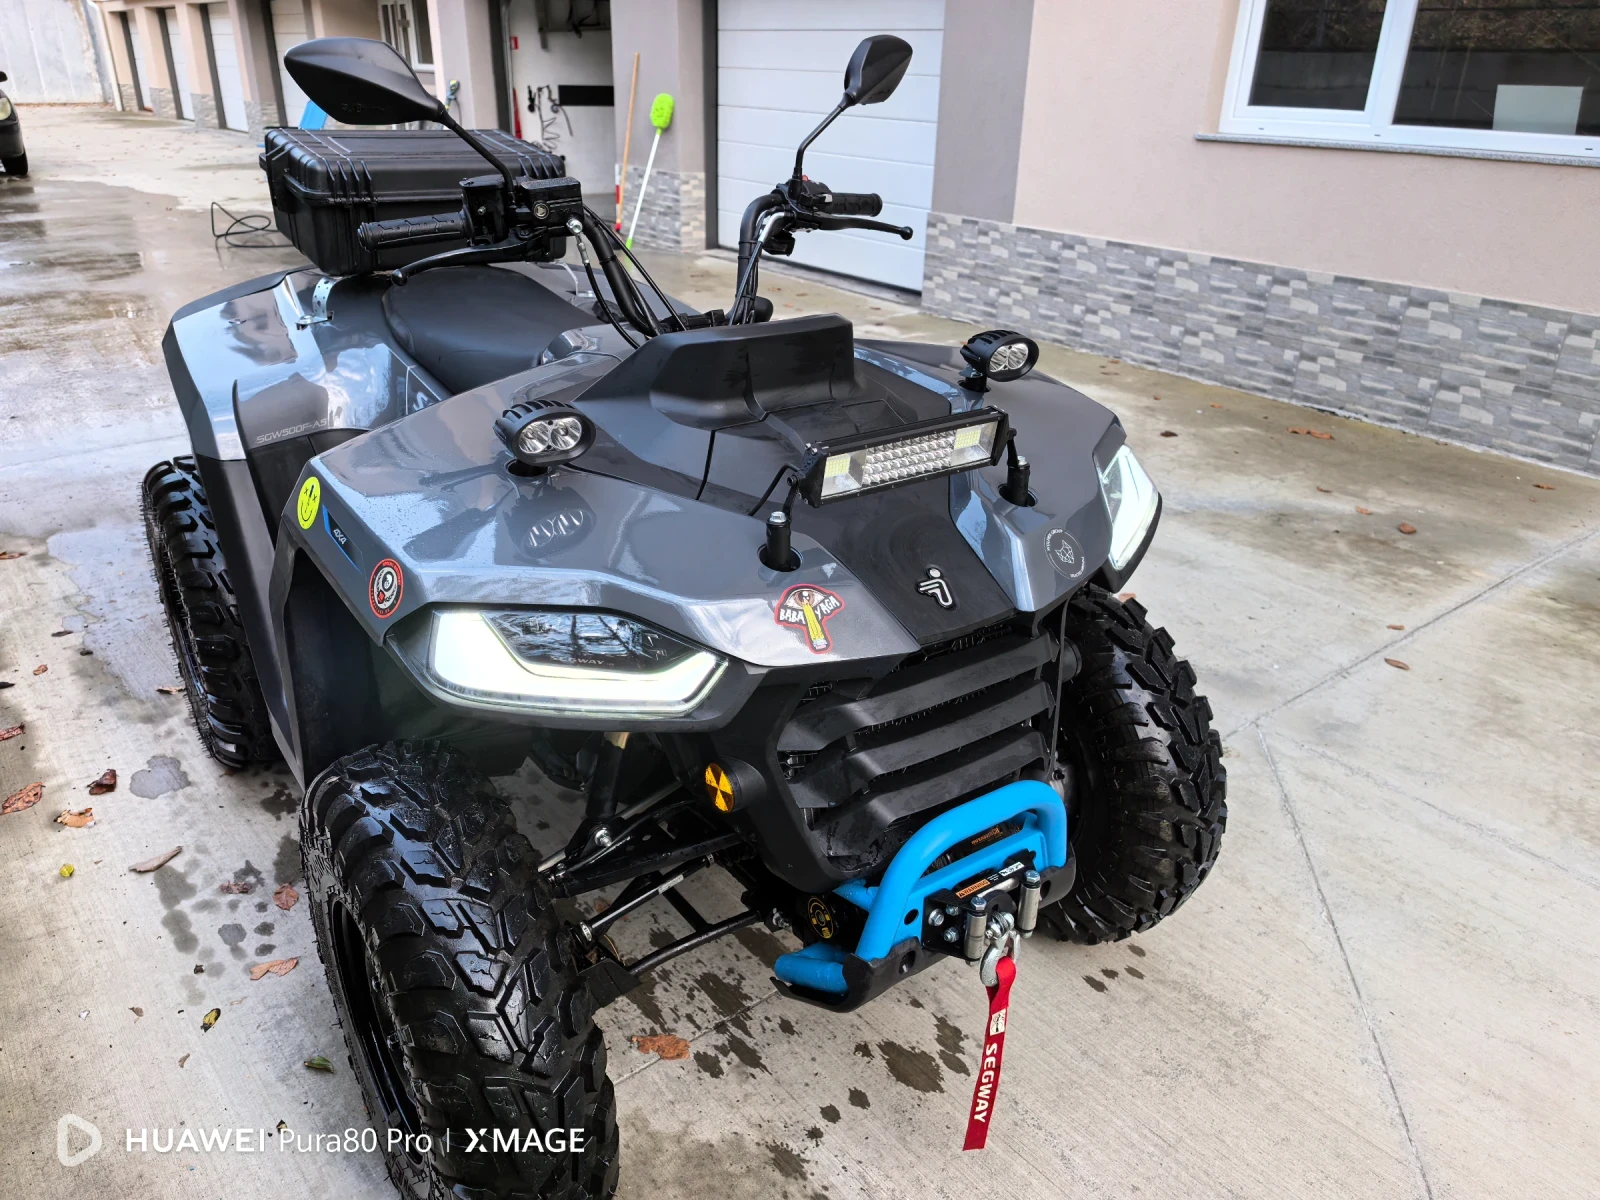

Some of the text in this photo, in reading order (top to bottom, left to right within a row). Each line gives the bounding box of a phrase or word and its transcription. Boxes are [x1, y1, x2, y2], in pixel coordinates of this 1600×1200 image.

[779, 595, 841, 625] BABA YAGA
[974, 1042, 998, 1123] SEGWAY
